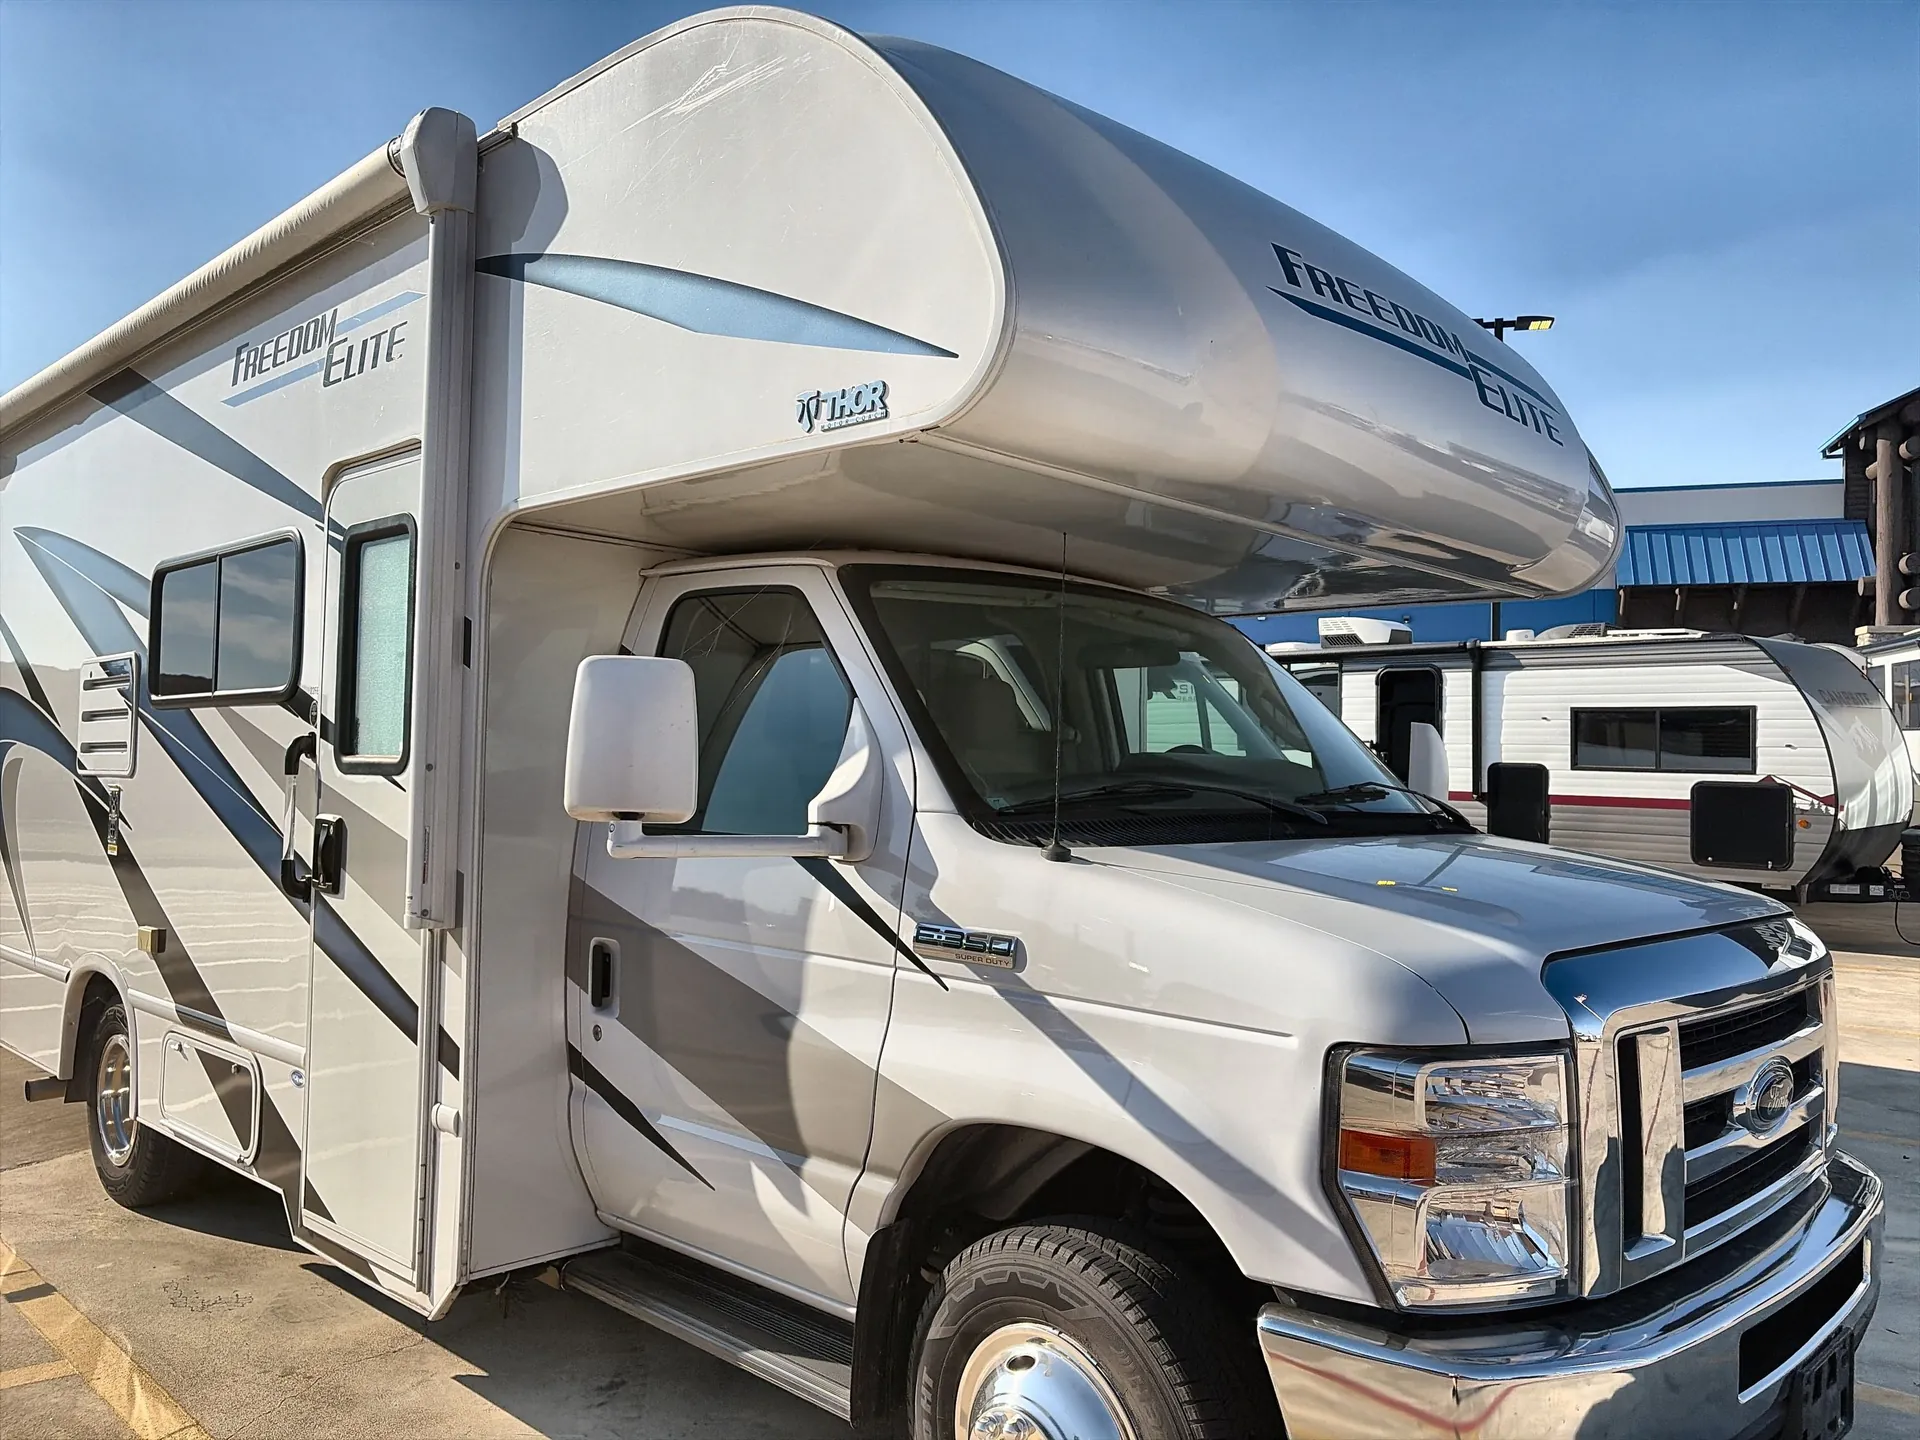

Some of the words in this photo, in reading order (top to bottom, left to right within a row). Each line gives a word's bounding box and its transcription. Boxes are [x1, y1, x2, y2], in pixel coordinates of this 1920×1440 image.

[1269, 242, 1471, 363] FREEDOM
[231, 308, 339, 388] FREEDOM
[322, 320, 408, 388] ELITE
[821, 380, 888, 421] THOR
[855, 410, 886, 423] COACH
[1468, 362, 1564, 447] ELITE
[954, 953, 985, 963] SUPER
[985, 957, 1010, 967] DUTY
